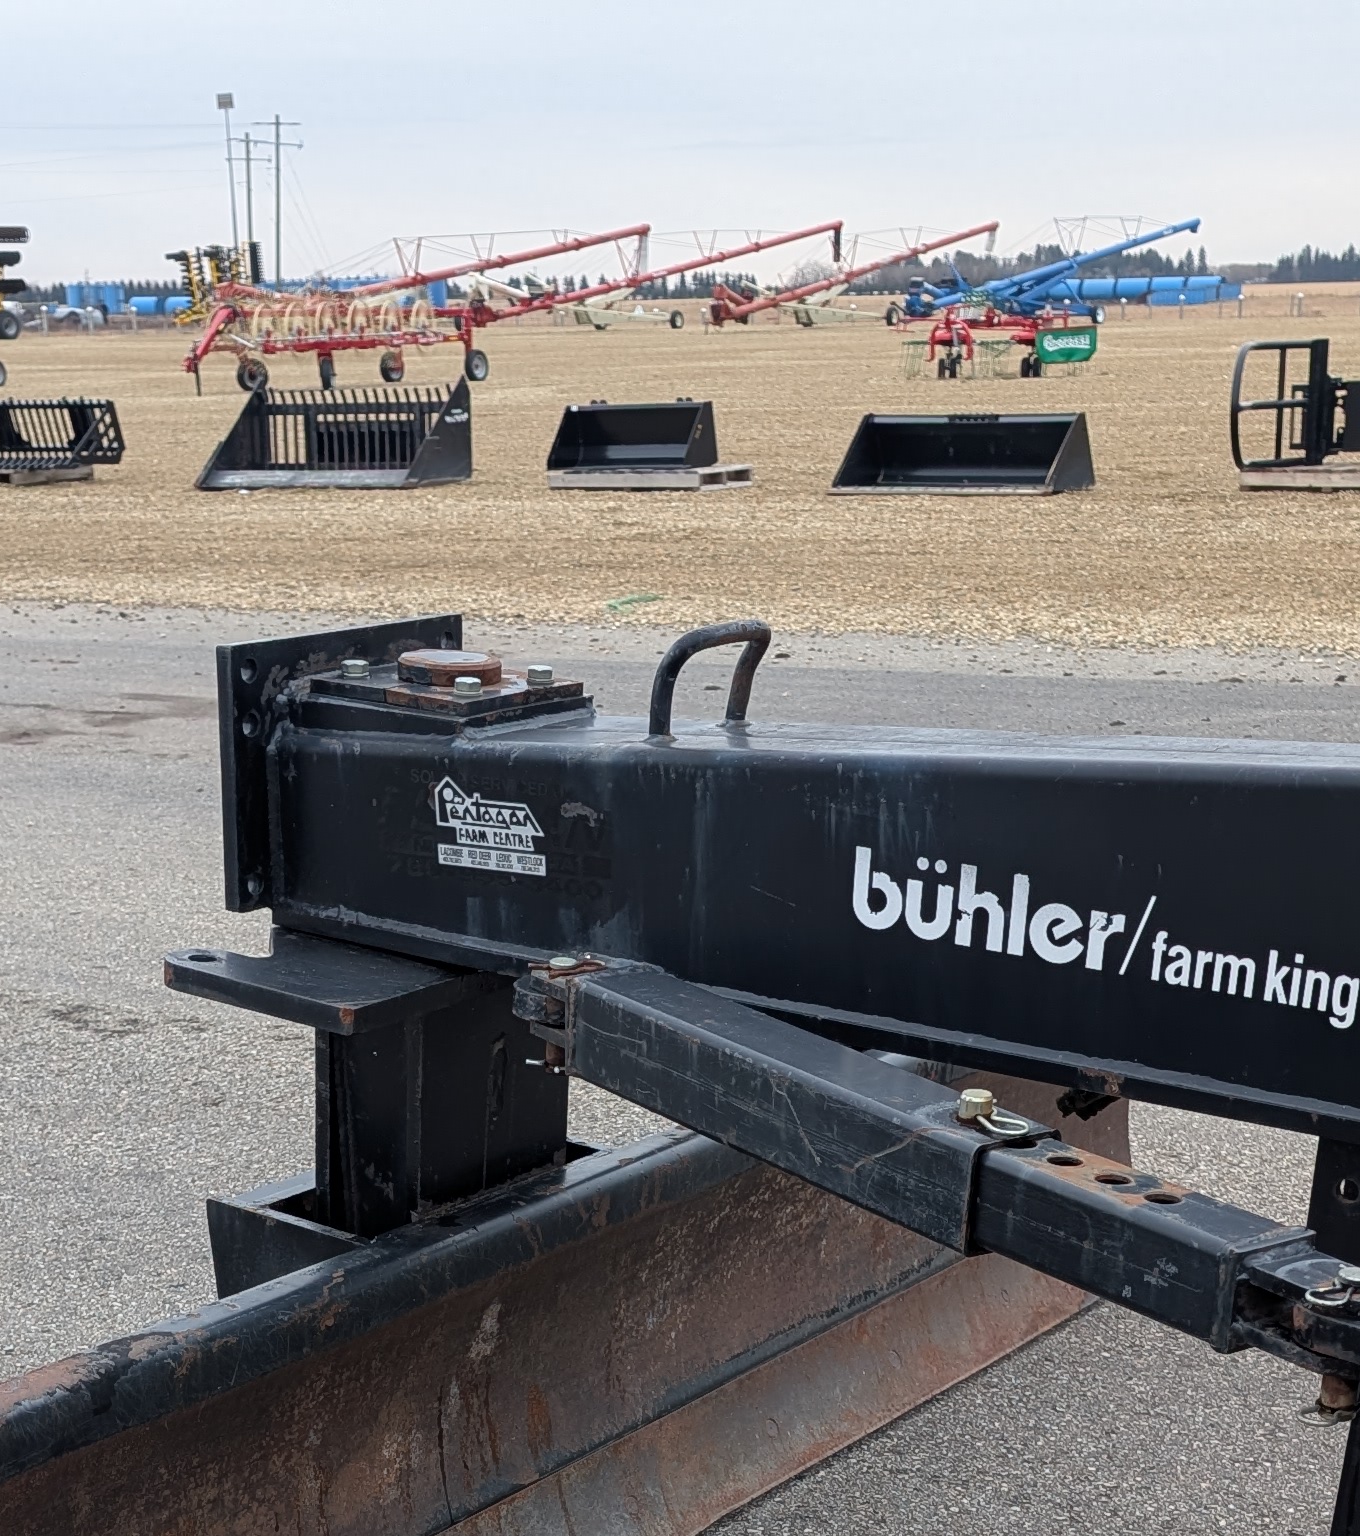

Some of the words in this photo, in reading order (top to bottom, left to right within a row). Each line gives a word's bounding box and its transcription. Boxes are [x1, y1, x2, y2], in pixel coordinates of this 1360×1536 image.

[459, 827, 490, 845] FARM
[493, 831, 532, 849] CENTRE
[1151, 931, 1256, 998] farm
[1264, 949, 1360, 1030] king
